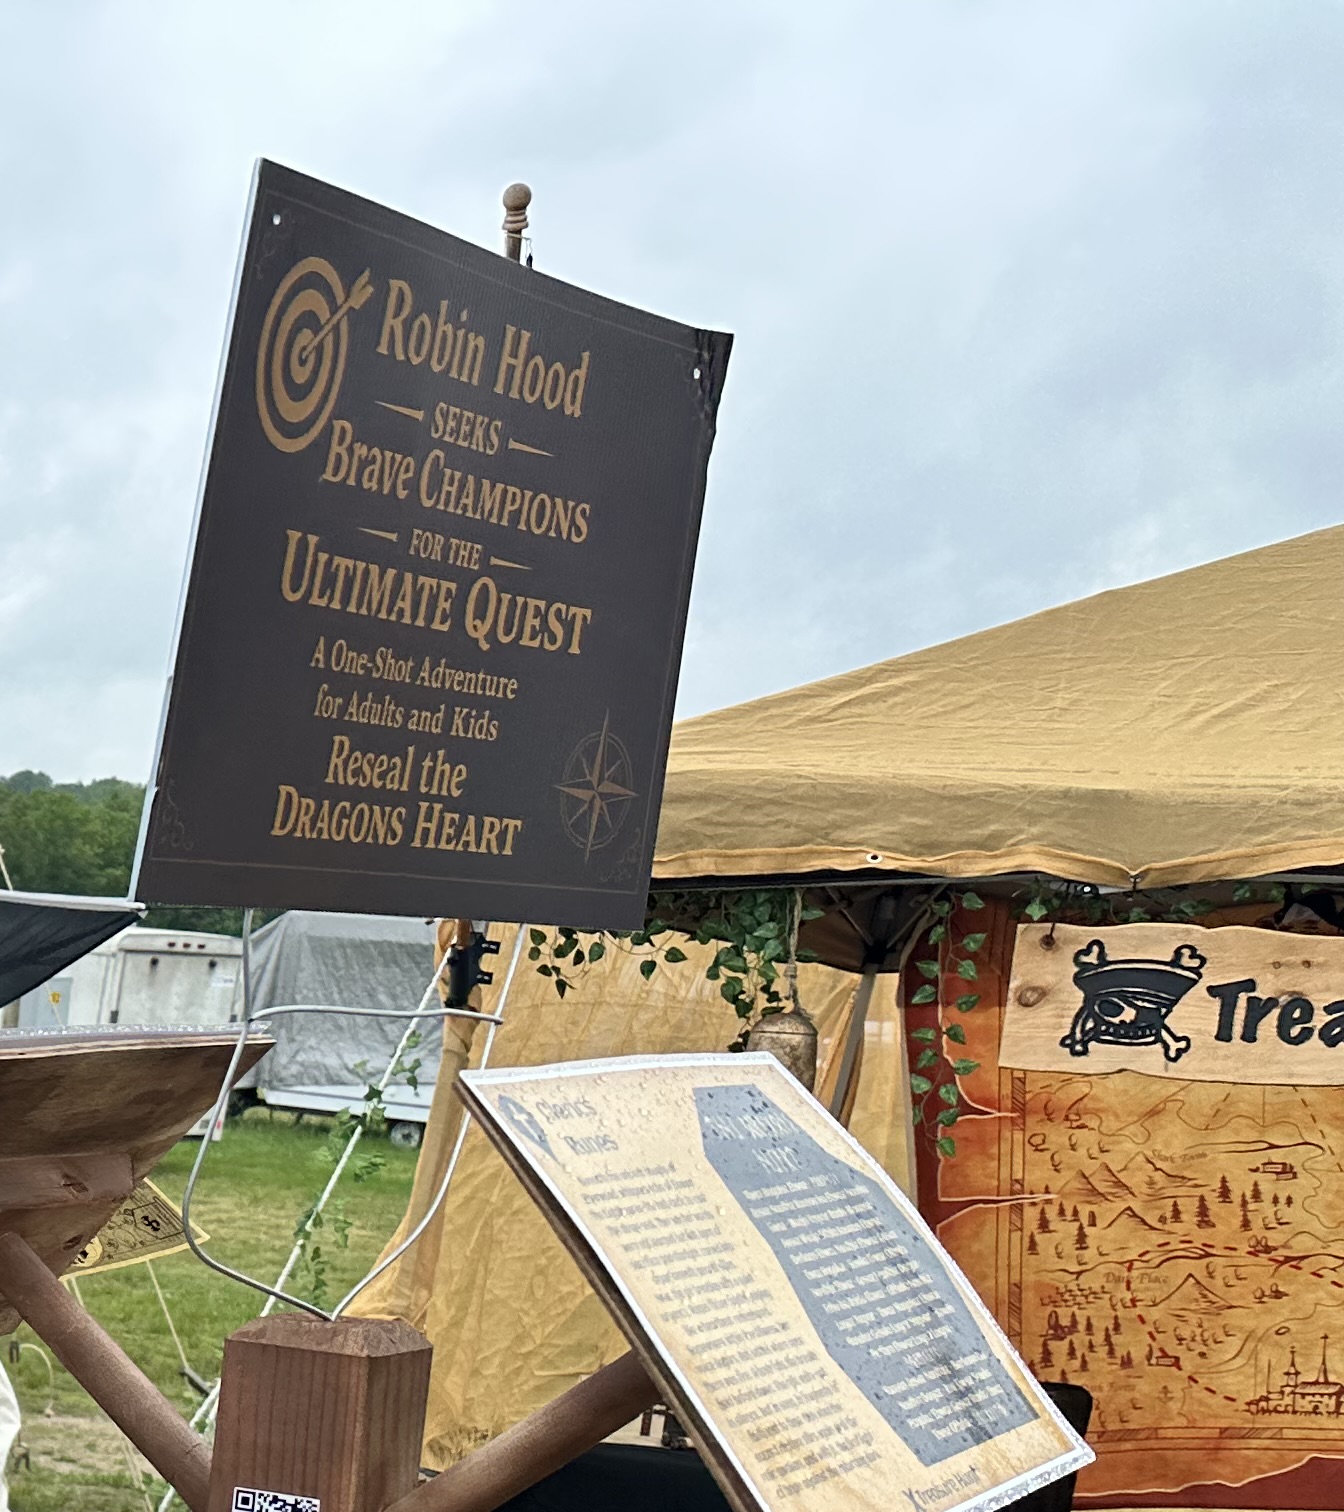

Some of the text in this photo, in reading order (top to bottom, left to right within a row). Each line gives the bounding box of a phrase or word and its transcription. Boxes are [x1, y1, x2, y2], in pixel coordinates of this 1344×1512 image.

[376, 278, 591, 419] Robin Hood
[430, 401, 503, 456] SEEKS
[318, 419, 591, 544] Brave CHAMPIONS
[408, 527, 484, 571] FOR THE
[281, 528, 593, 656] ULTIMATE QUEST
[309, 635, 519, 700] A One-Shot Adventure
[313, 682, 500, 742] for Adults and Kids
[323, 734, 468, 799] Reseal the
[270, 784, 523, 857] DRAGONS HEART
